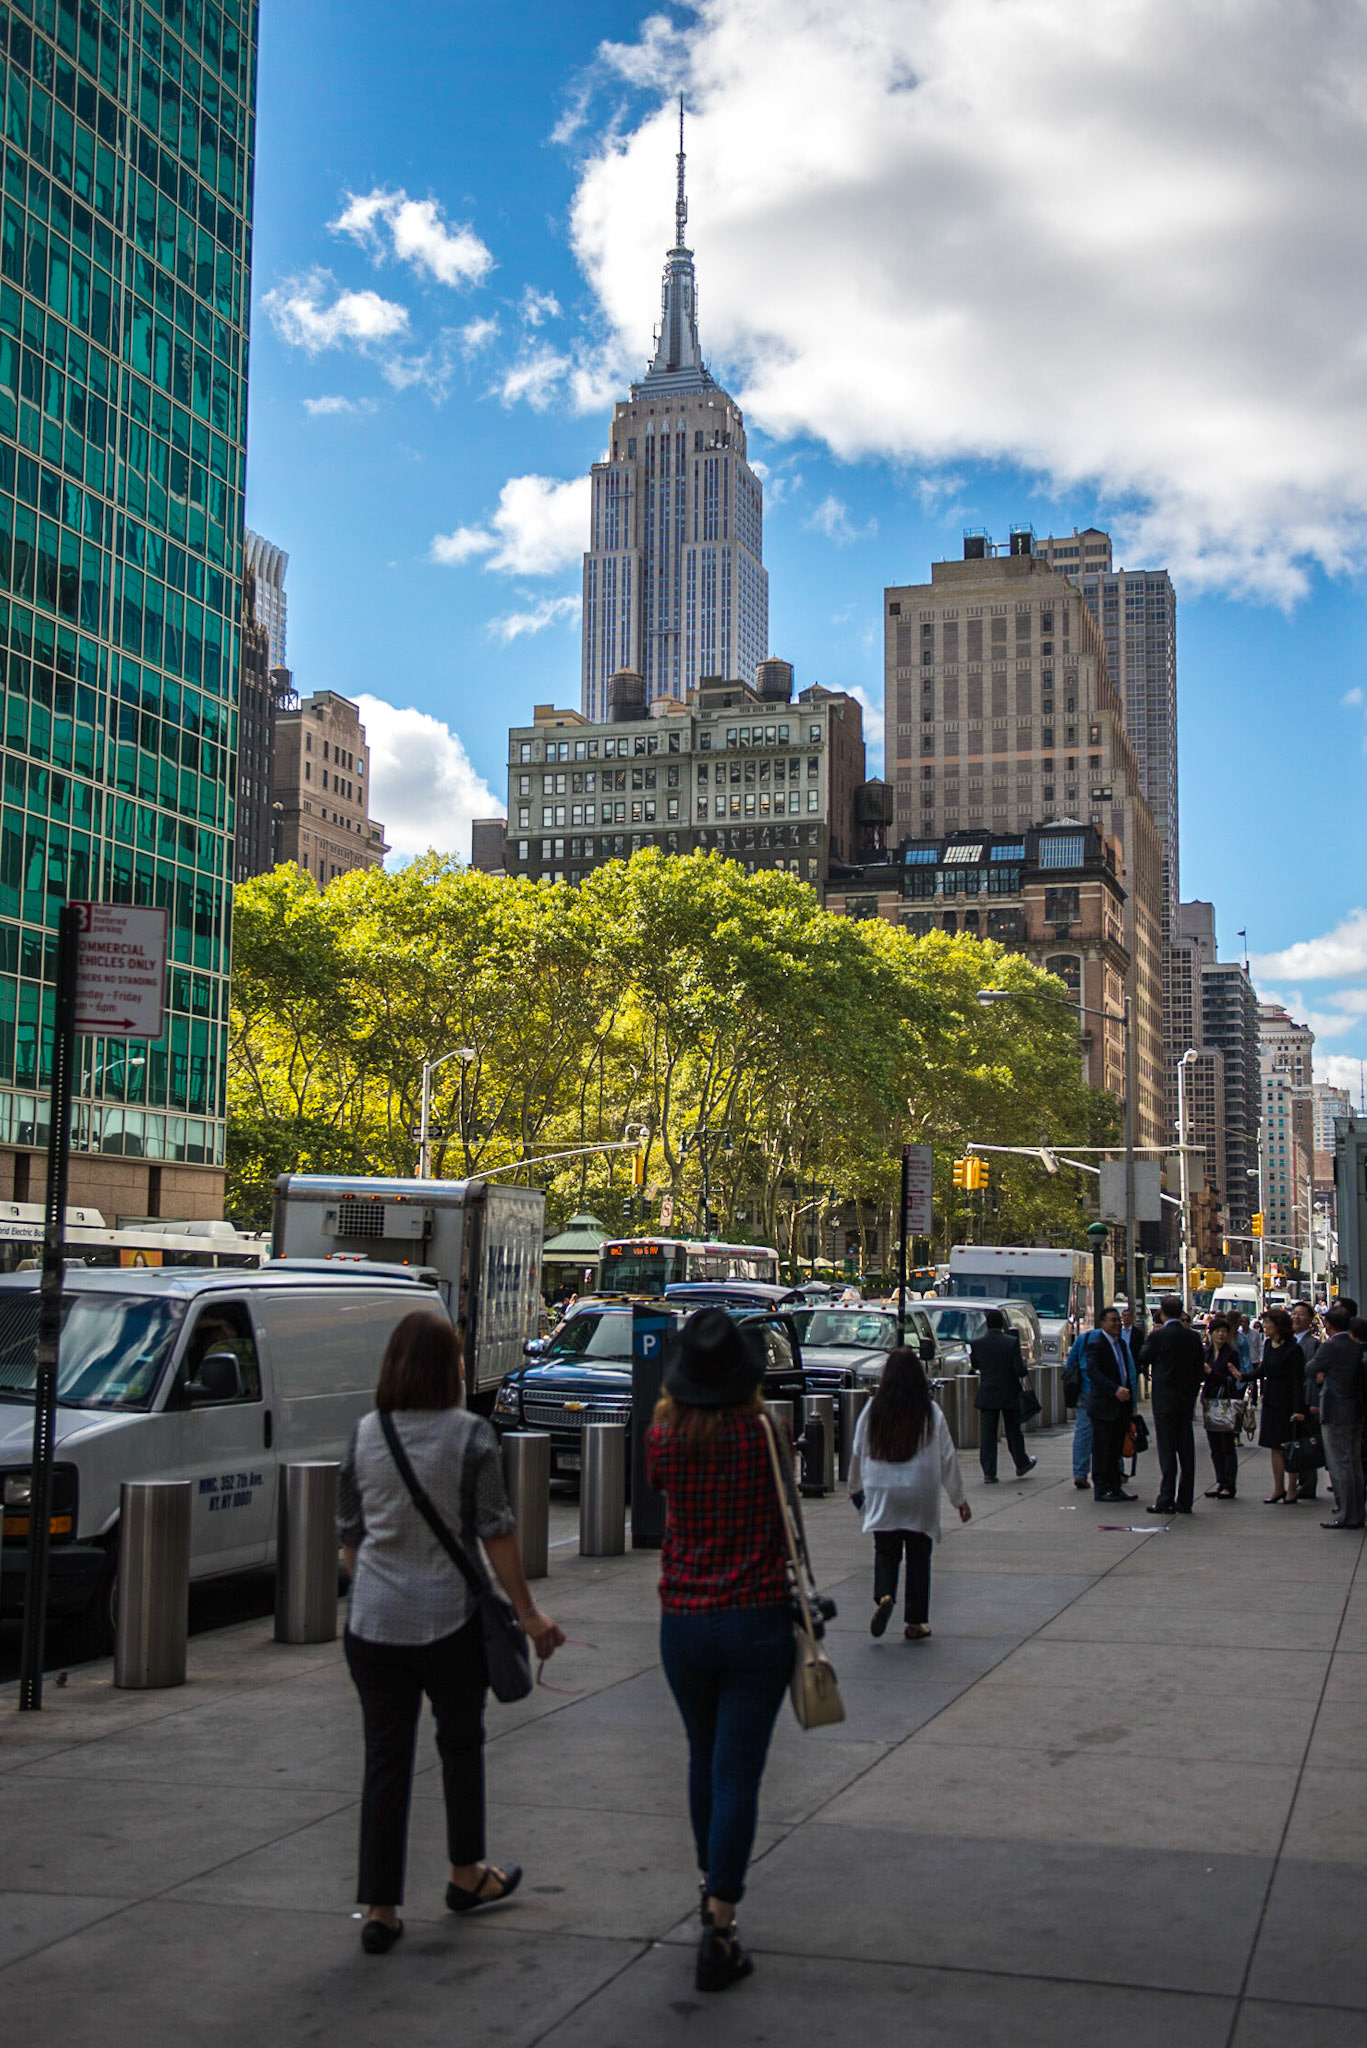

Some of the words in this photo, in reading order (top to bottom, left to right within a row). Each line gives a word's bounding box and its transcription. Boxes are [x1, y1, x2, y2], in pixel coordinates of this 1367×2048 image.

[73, 905, 88, 930] 3
[94, 907, 112, 916] hour
[94, 916, 128, 926] metered
[93, 925, 123, 935] parking
[79, 940, 146, 956] OMMERCIAL
[78, 954, 126, 969] EHICLES
[127, 958, 157, 971] ONLY
[104, 975, 117, 984] NO
[118, 976, 158, 987] STANDING
[76, 989, 105, 1002] onday
[113, 990, 143, 1004] Friday
[96, 1001, 117, 1013] 6pm
[11, 1227, 33, 1237] Electric
[643, 1334, 656, 1355] P
